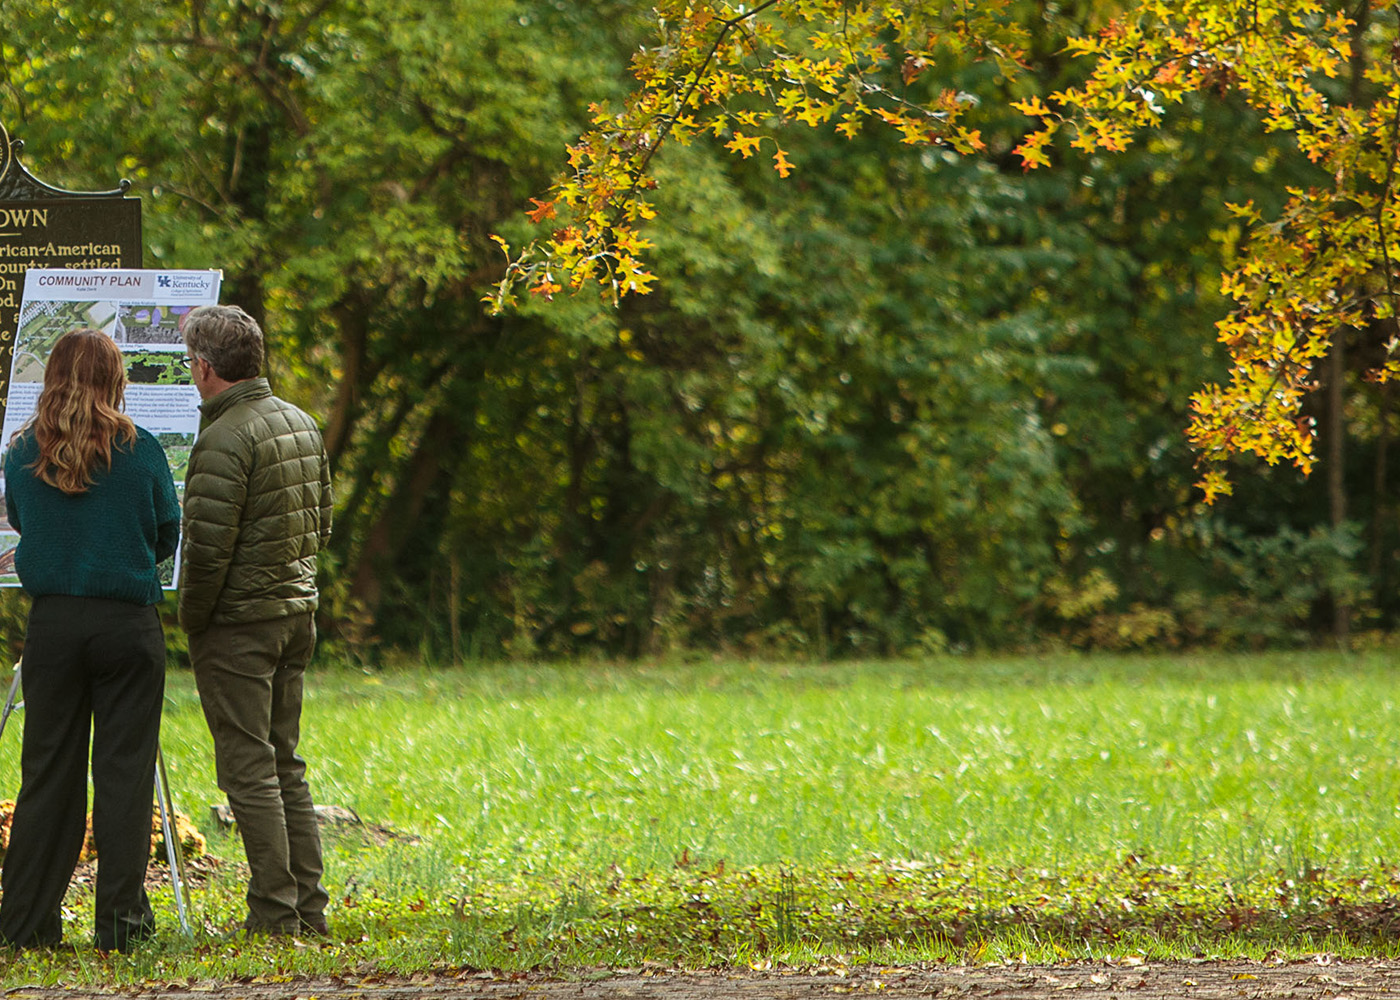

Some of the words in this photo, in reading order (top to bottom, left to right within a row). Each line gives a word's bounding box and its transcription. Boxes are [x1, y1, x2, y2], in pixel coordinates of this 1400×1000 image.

[65, 257, 121, 270] settled
[38, 275, 108, 287] COMMUNITY
[109, 276, 142, 287] PLAN
[172, 280, 211, 290] Kentucky
